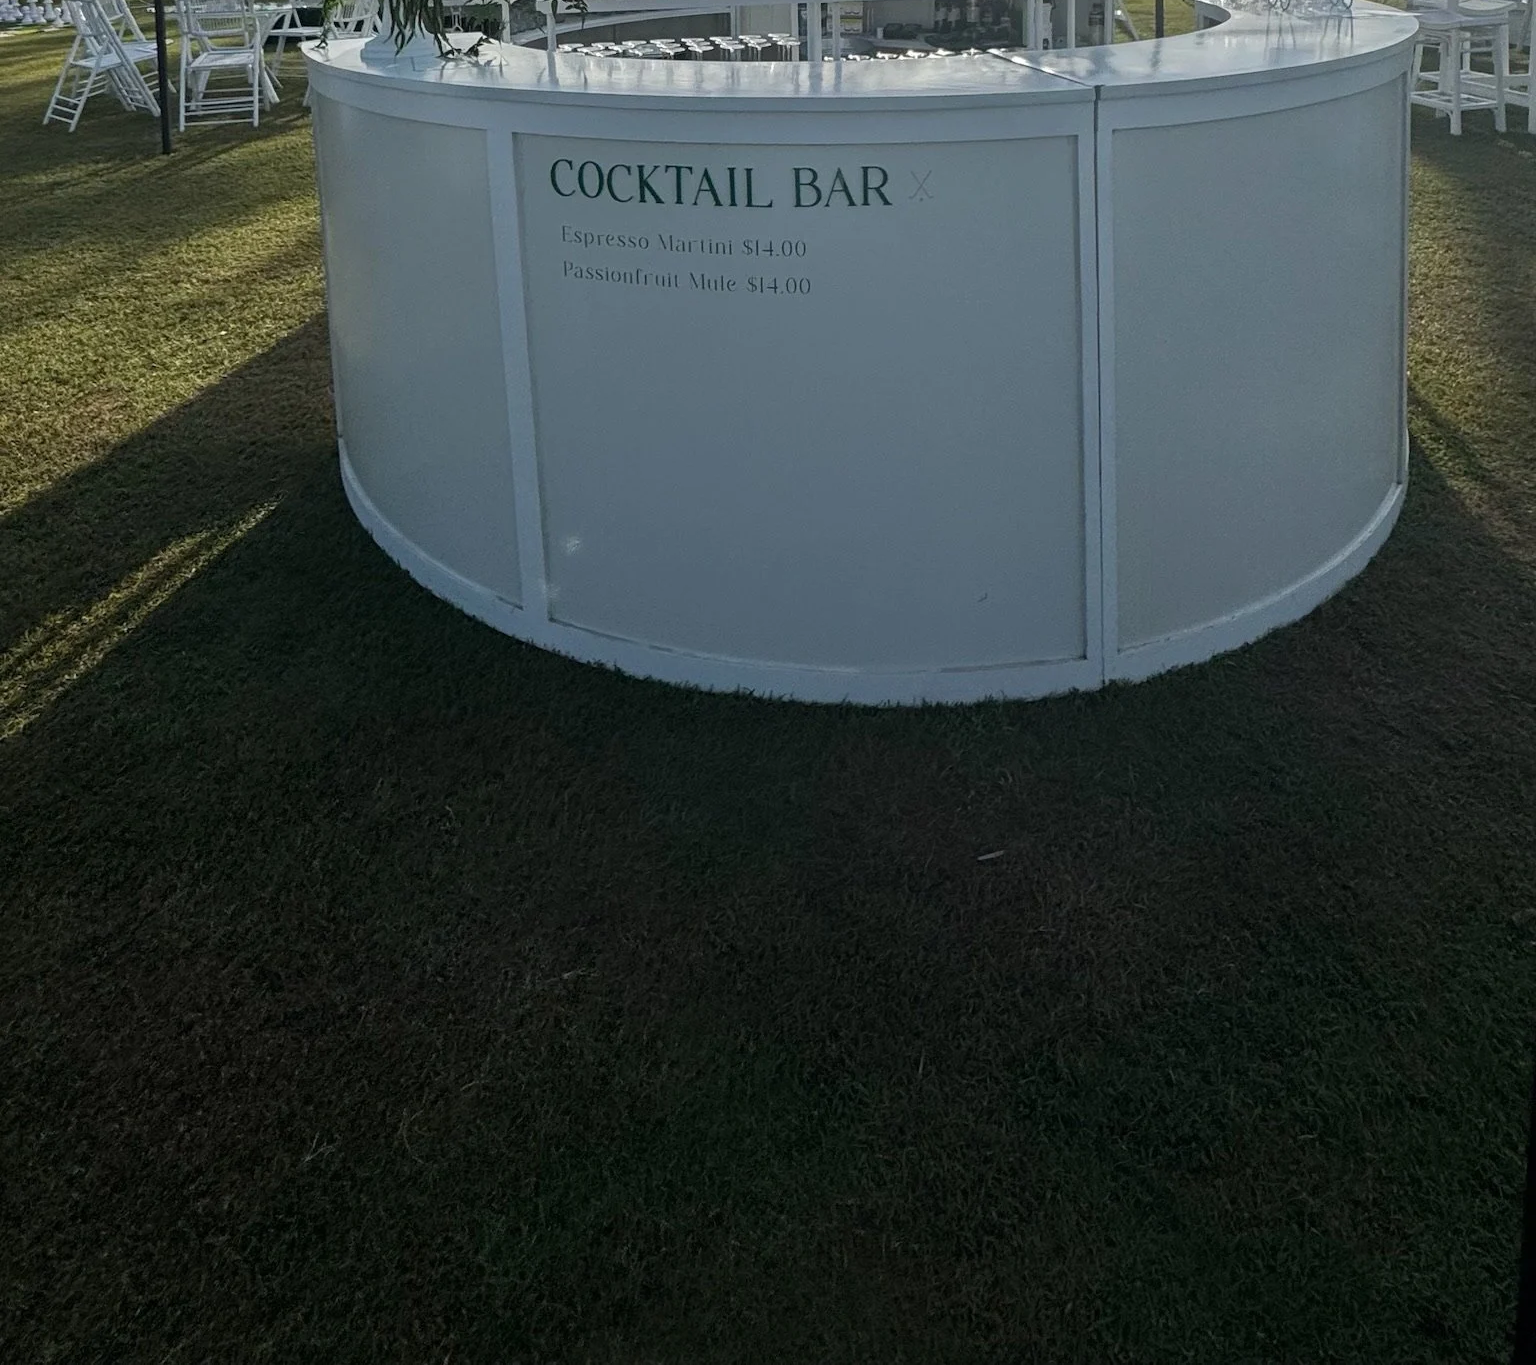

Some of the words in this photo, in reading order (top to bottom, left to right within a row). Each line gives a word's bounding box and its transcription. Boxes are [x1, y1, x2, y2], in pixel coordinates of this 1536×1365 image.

[550, 158, 774, 209] COCKTAIL
[792, 165, 893, 208] BAR
[561, 225, 650, 251] Espresso
[659, 233, 733, 256] Martini
[741, 238, 807, 259] $14.00
[563, 260, 681, 289] Passionfruit
[689, 271, 737, 293] Mule
[746, 276, 812, 296] $14.00
